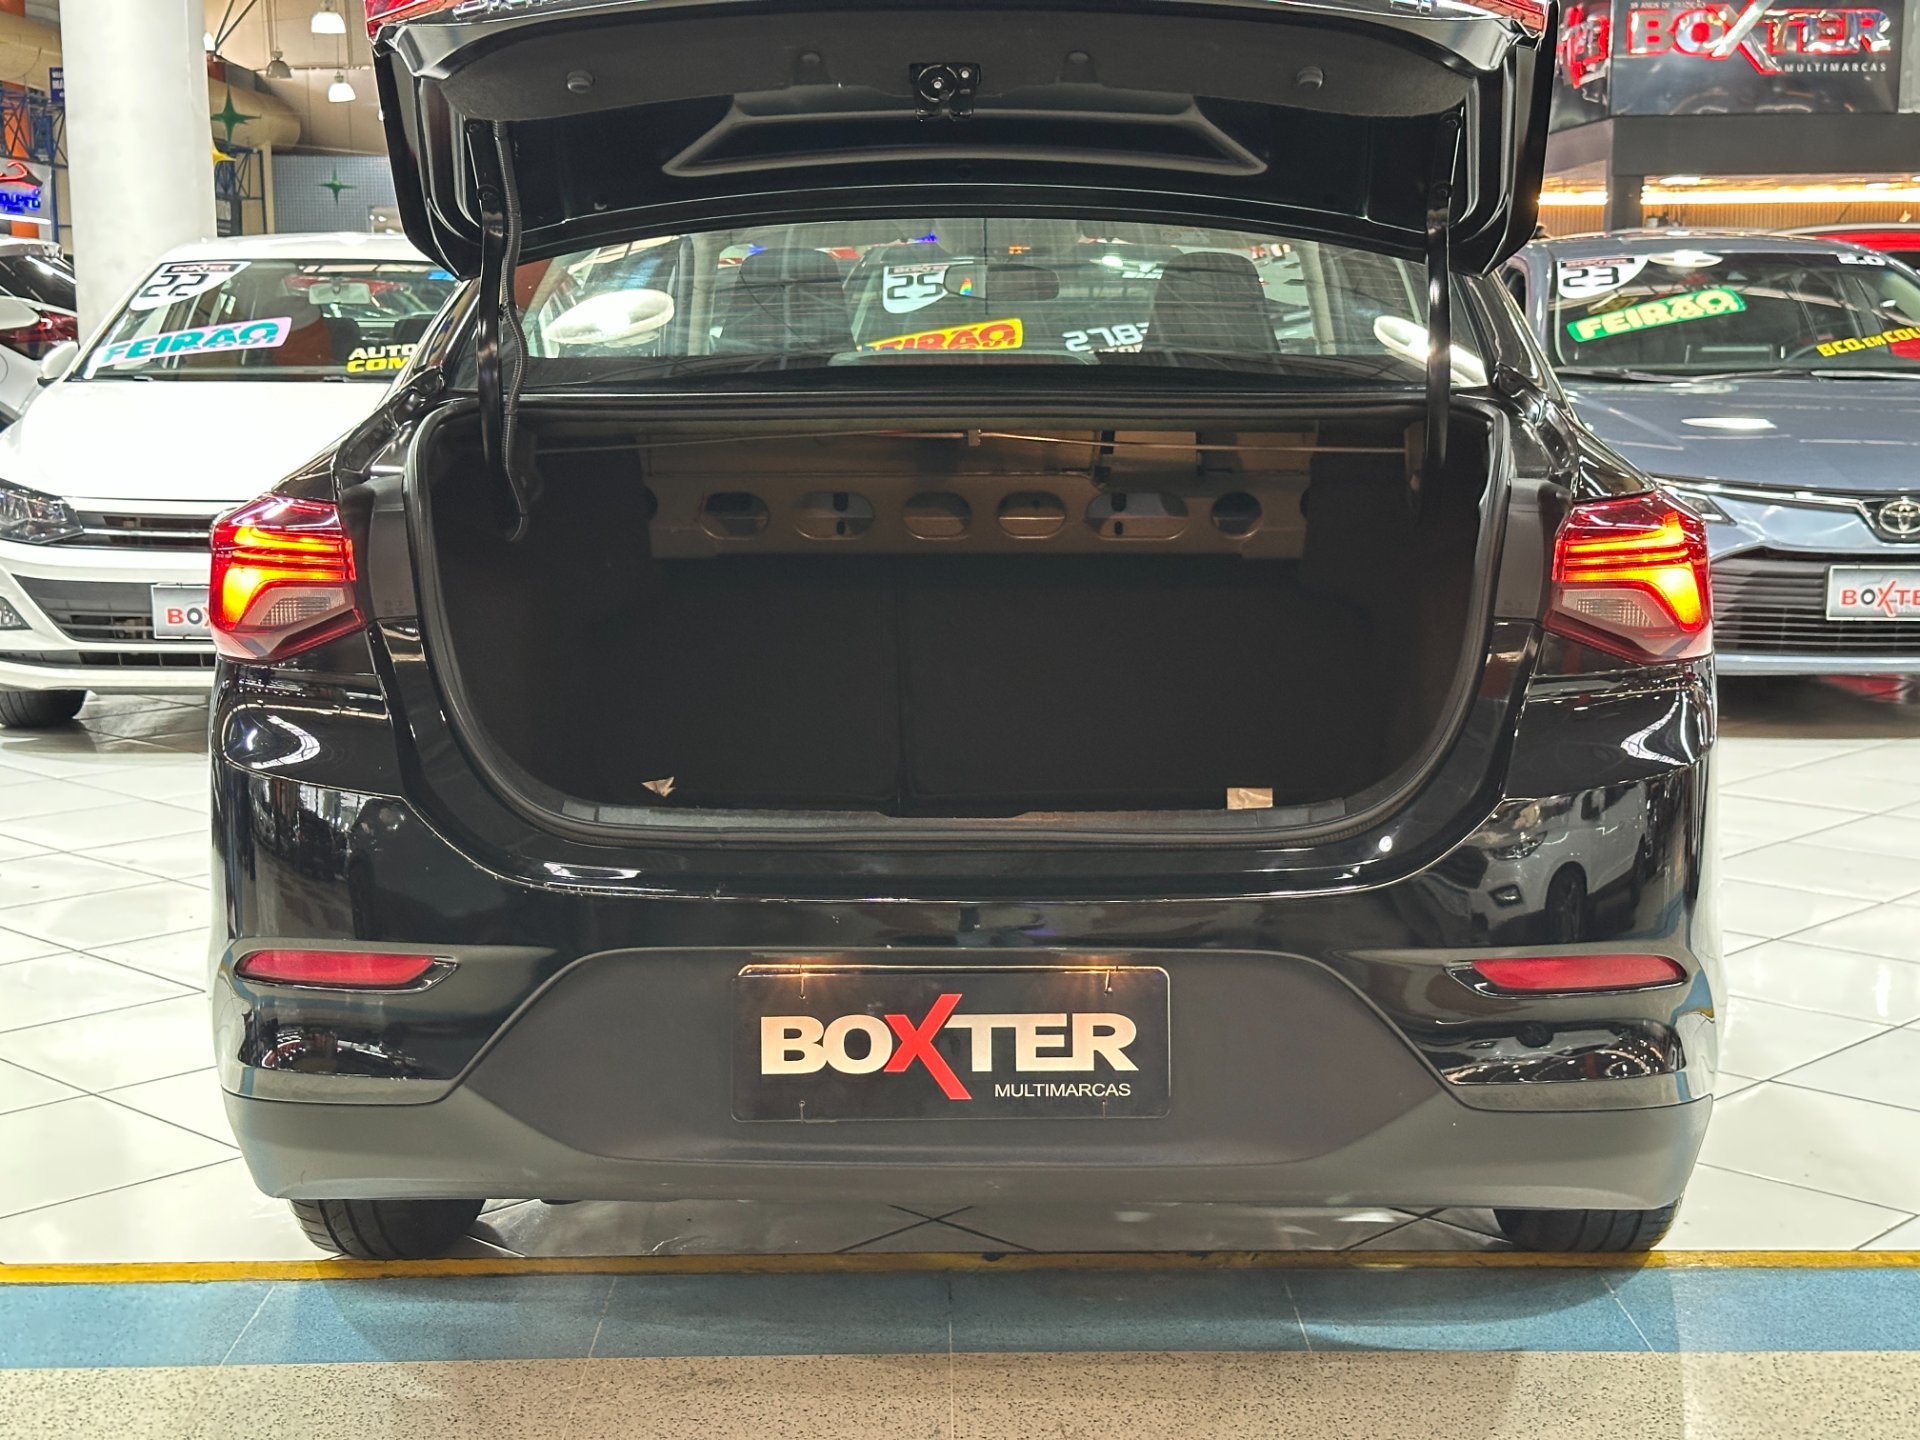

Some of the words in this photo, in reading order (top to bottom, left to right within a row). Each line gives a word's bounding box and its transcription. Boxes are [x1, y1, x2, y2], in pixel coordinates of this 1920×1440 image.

[1626, 0, 1891, 74] BOXTER
[1784, 63, 1888, 73] MULTIMARCAS
[139, 273, 210, 297] 22
[886, 272, 944, 299] 25
[1563, 266, 1620, 288] 23
[348, 343, 418, 361] AUTO
[760, 993, 1139, 1100] BOXTER
[994, 1082, 1132, 1099] MULTIMARCAS
